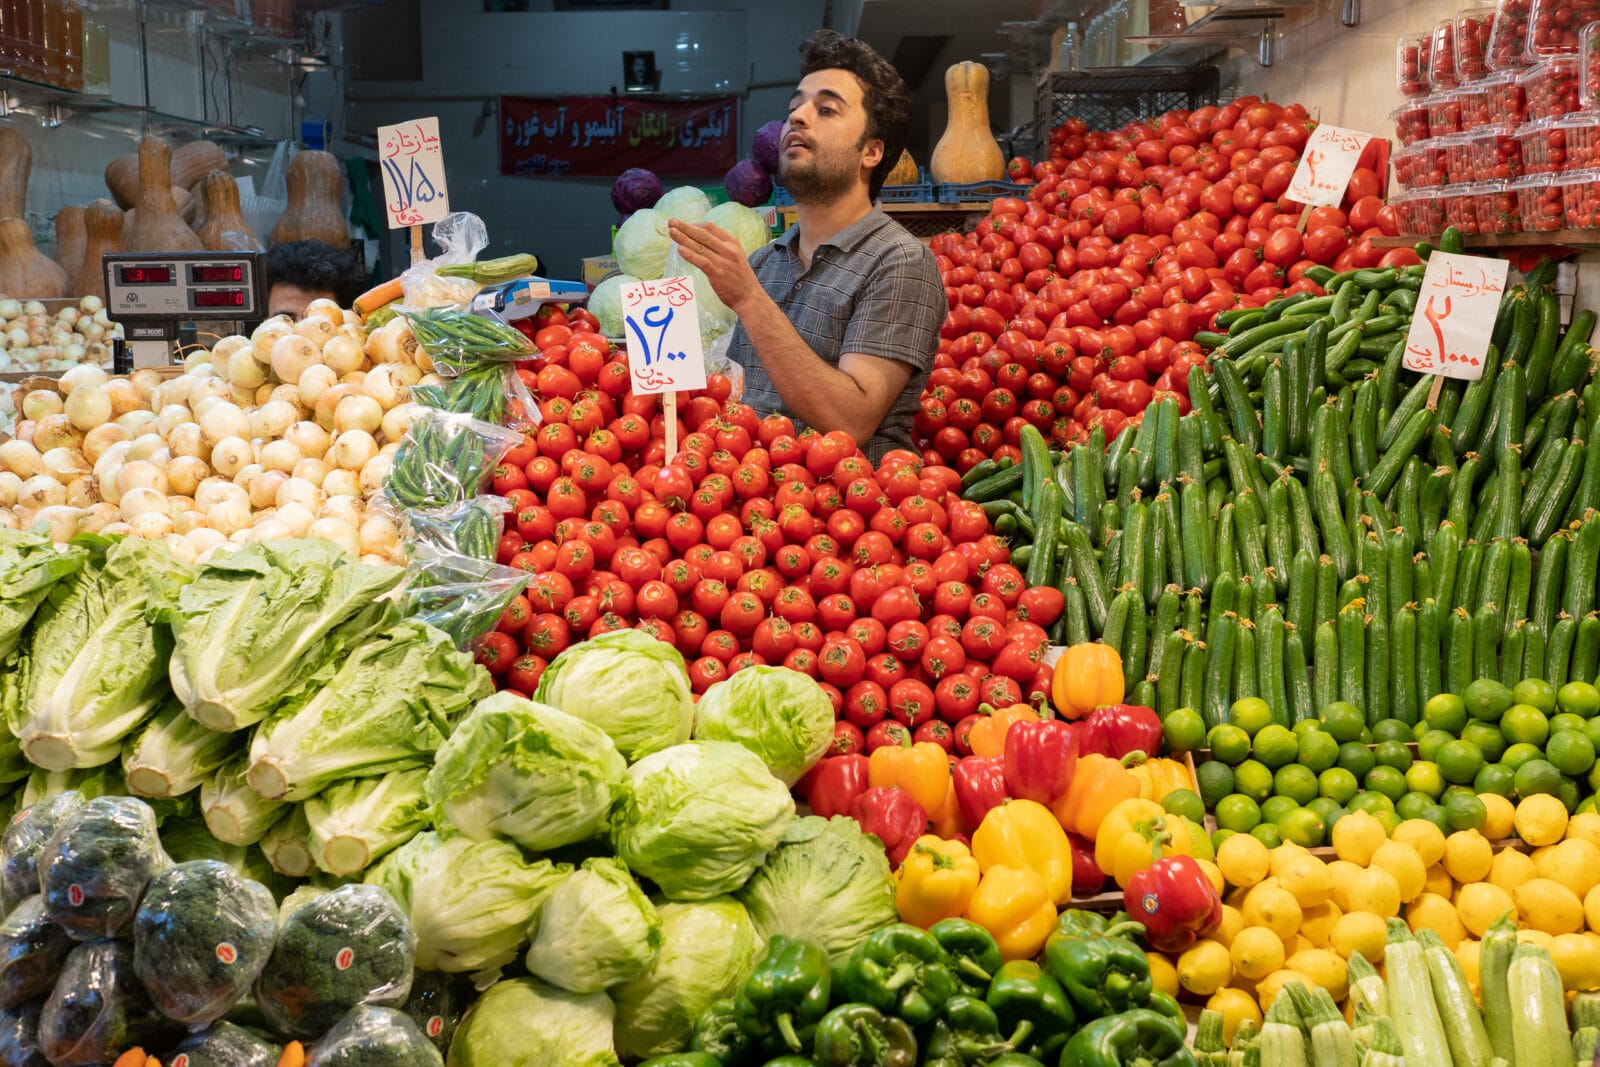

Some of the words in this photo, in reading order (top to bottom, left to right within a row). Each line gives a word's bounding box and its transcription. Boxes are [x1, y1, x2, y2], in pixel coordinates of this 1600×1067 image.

[505, 110, 540, 147] غوره
[542, 106, 568, 136] آب
[571, 120, 580, 147] و
[583, 105, 626, 147] آبلیمو
[628, 110, 676, 147] رایگان
[679, 105, 731, 147] آبگیری
[385, 129, 415, 158] تازه
[405, 124, 439, 155] پیاز
[382, 155, 445, 211] ۱۷۵۰
[627, 282, 655, 307] تازه
[658, 276, 694, 307] گوجه
[1461, 267, 1502, 298] خیار
[625, 305, 687, 366] ۱۶۰۰
